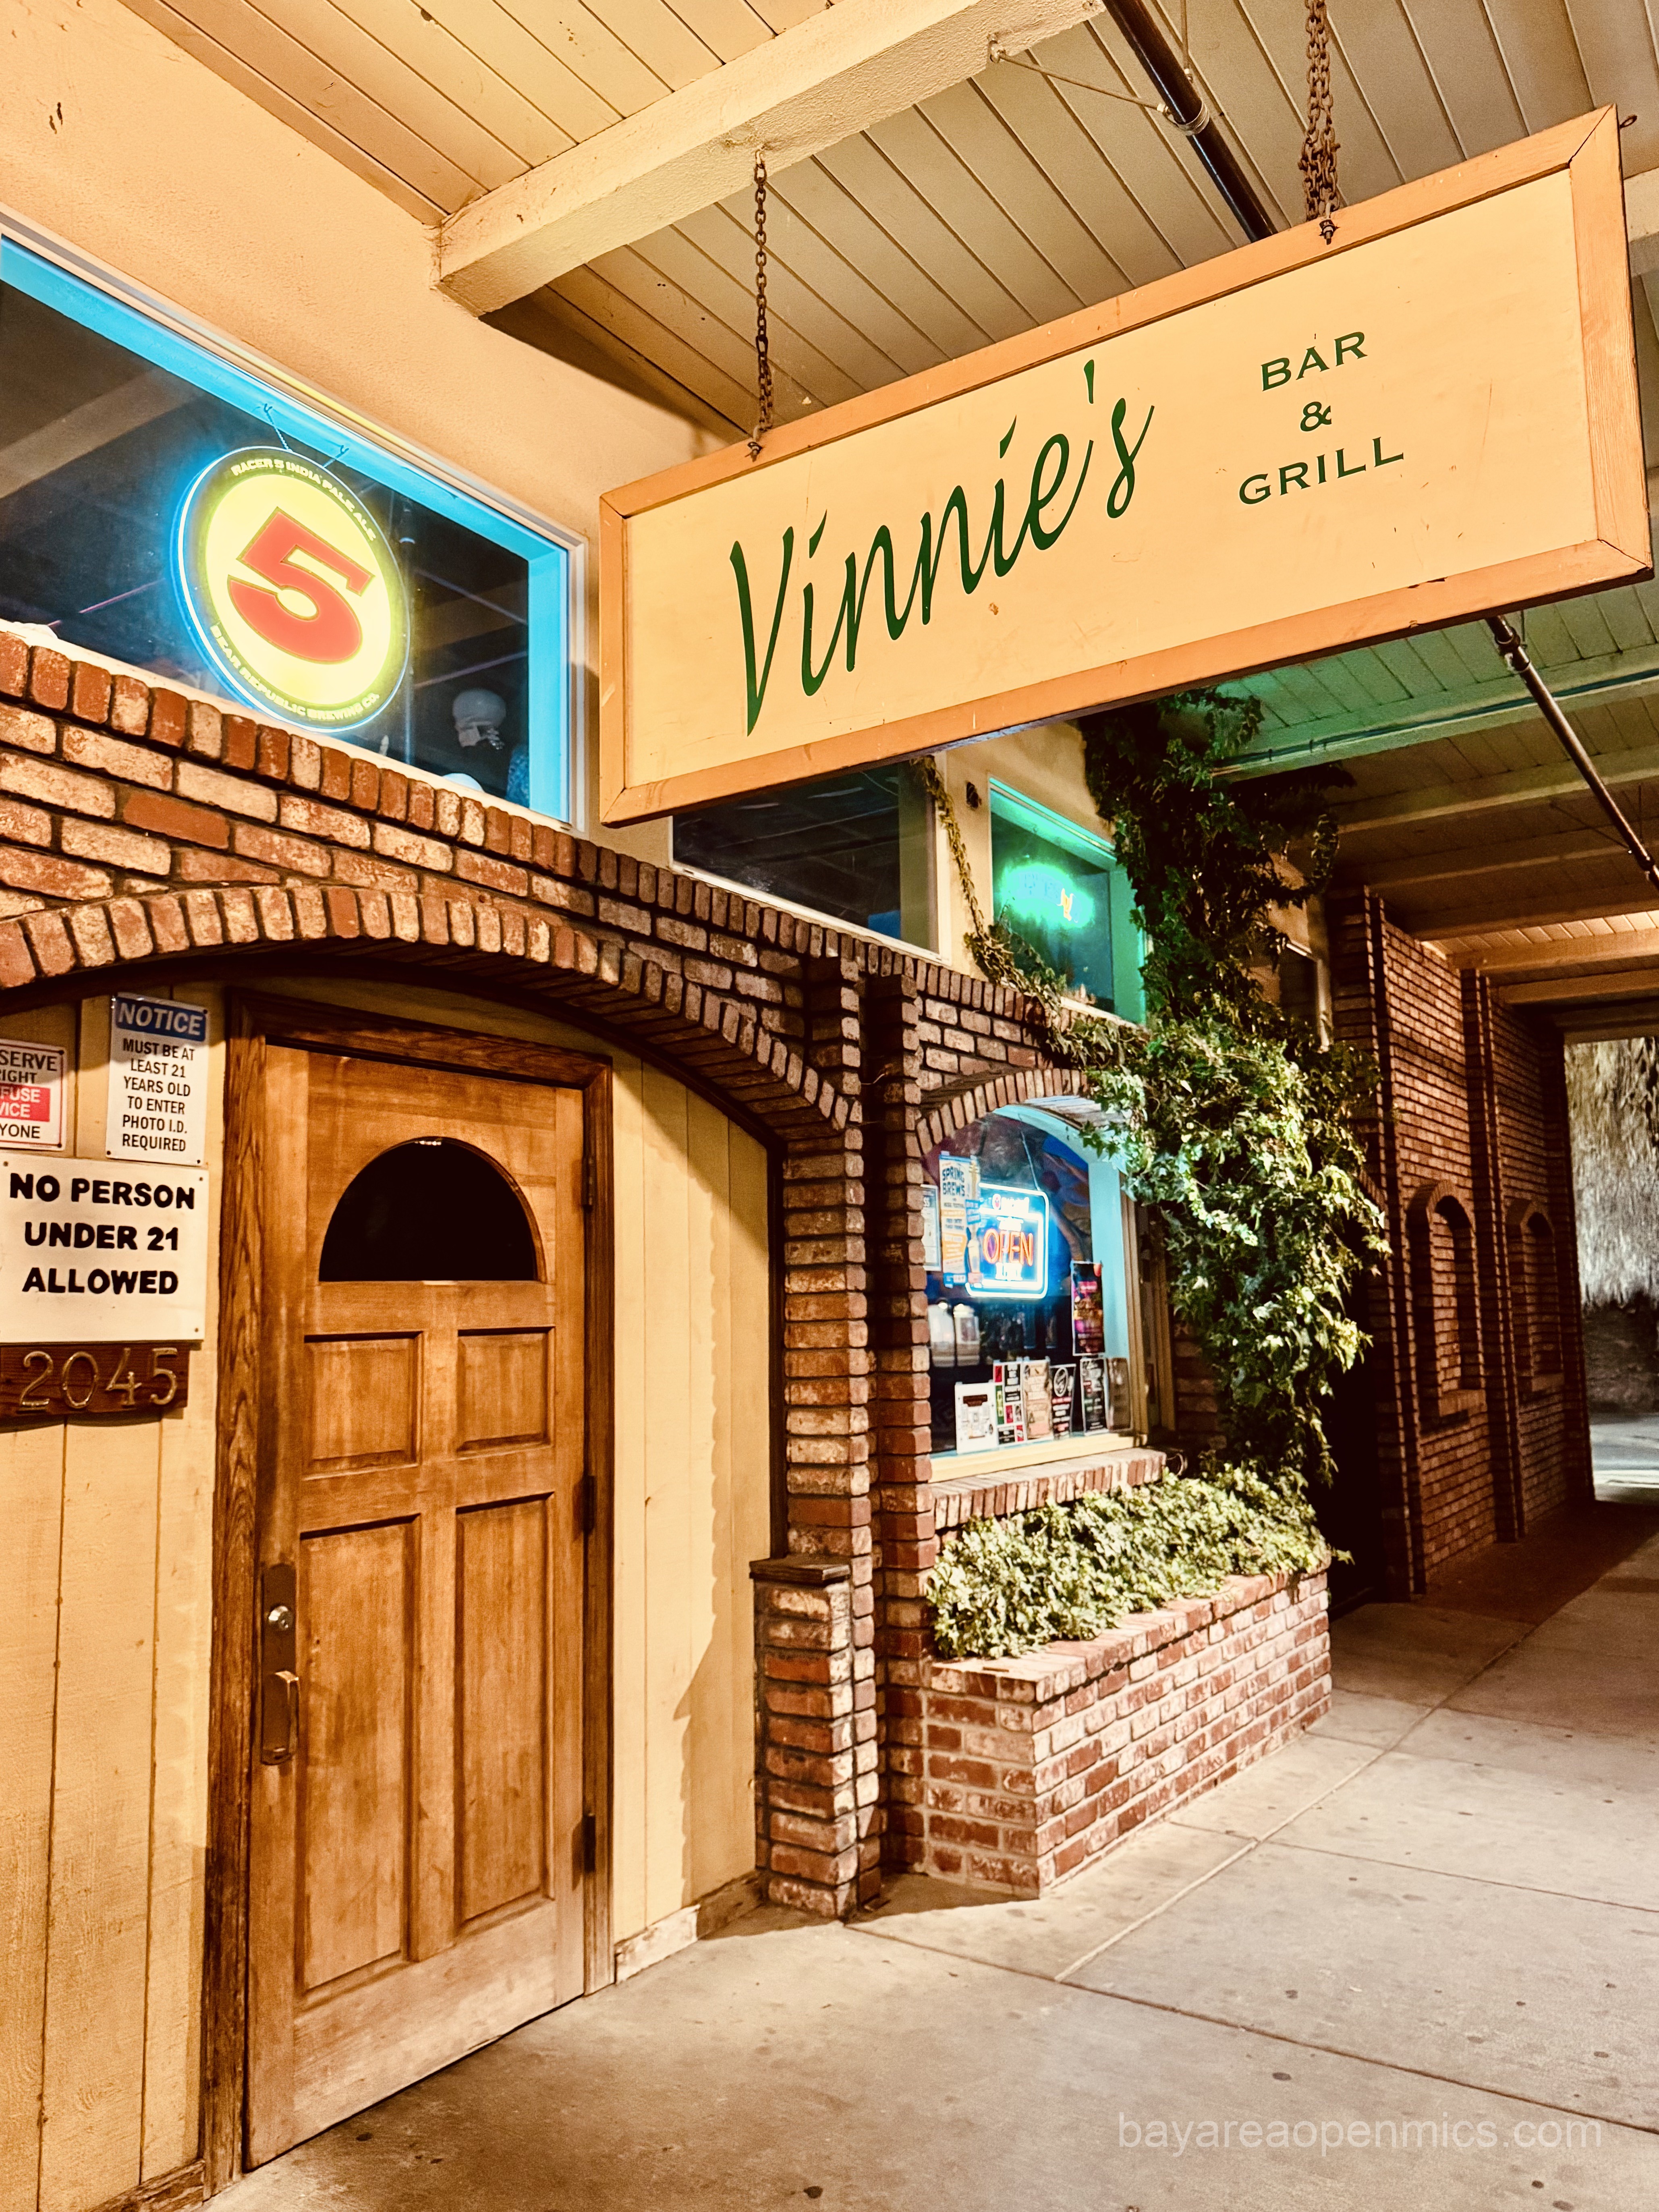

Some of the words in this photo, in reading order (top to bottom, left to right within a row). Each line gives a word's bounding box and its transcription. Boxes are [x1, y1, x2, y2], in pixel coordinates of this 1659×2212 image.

[1261, 331, 1368, 392] BAR
[1300, 401, 1332, 432] &
[1239, 436, 1404, 505] GRILL
[231, 458, 274, 476] RACER
[274, 459, 284, 469] 5
[285, 461, 321, 484] INDIA
[322, 479, 355, 512] PALE
[353, 512, 376, 541] ALE
[730, 359, 1155, 736] Vinnie's
[227, 506, 375, 665] 5
[210, 625, 241, 669] BEAR
[239, 667, 306, 717] REPUBLIC
[307, 702, 363, 720] BREWING
[118, 1002, 203, 1036] NOTICE
[123, 1038, 160, 1055] MUST
[162, 1044, 179, 1058] BE
[182, 1048, 195, 1061] AT
[0, 1069, 37, 1084] IGHT
[131, 1058, 168, 1075] LEAST
[171, 1064, 186, 1078] 21
[124, 1076, 163, 1093] YEARS
[168, 1082, 191, 1097] OLD
[127, 1095, 143, 1109] TO
[147, 1098, 185, 1115] ENTER
[122, 1114, 165, 1131] PHOTO
[169, 1119, 187, 1134] I.D.
[122, 1133, 186, 1152] REQUIRED
[941, 1166, 965, 1183] SPRING
[942, 1182, 965, 1196] BREWS
[10, 1173, 60, 1202] NO
[71, 1178, 195, 1210] PERSON
[24, 1221, 138, 1250] UNDER
[147, 1227, 178, 1251] 21
[983, 1228, 1034, 1266] OPEN
[22, 1267, 179, 1295] ALLOWED
[19, 1347, 178, 1410] 2045
